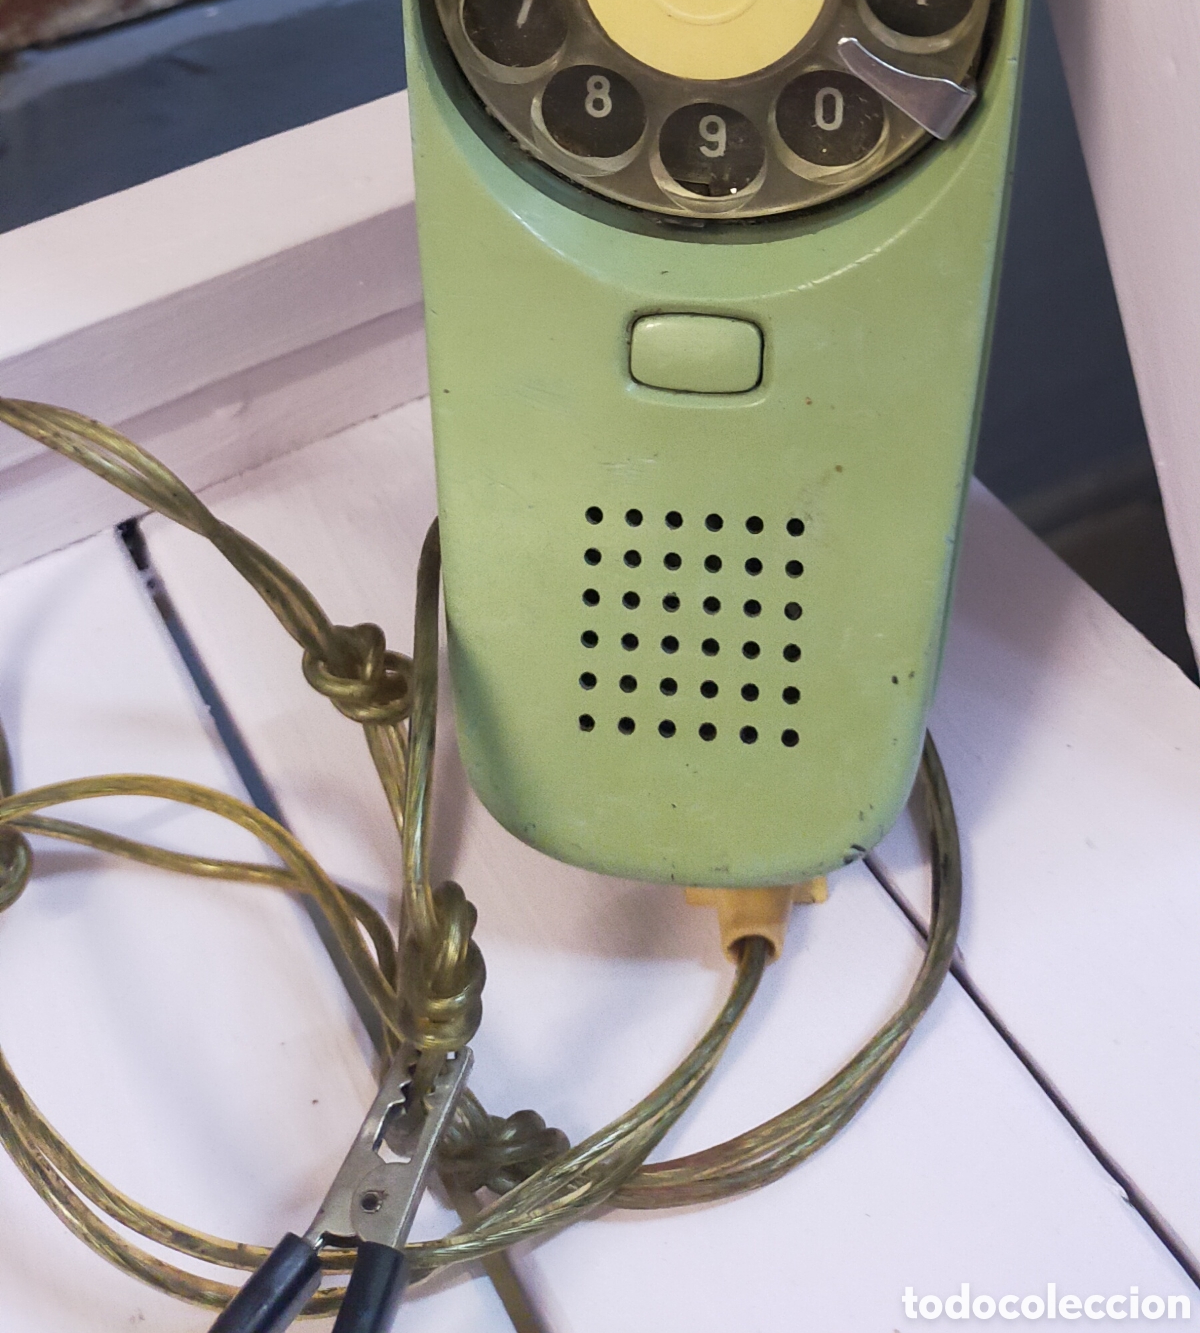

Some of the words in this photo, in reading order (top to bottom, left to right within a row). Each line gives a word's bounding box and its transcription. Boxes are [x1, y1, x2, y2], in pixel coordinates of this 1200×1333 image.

[585, 74, 613, 118] 8
[814, 87, 844, 130] 0
[698, 114, 728, 158] 9
